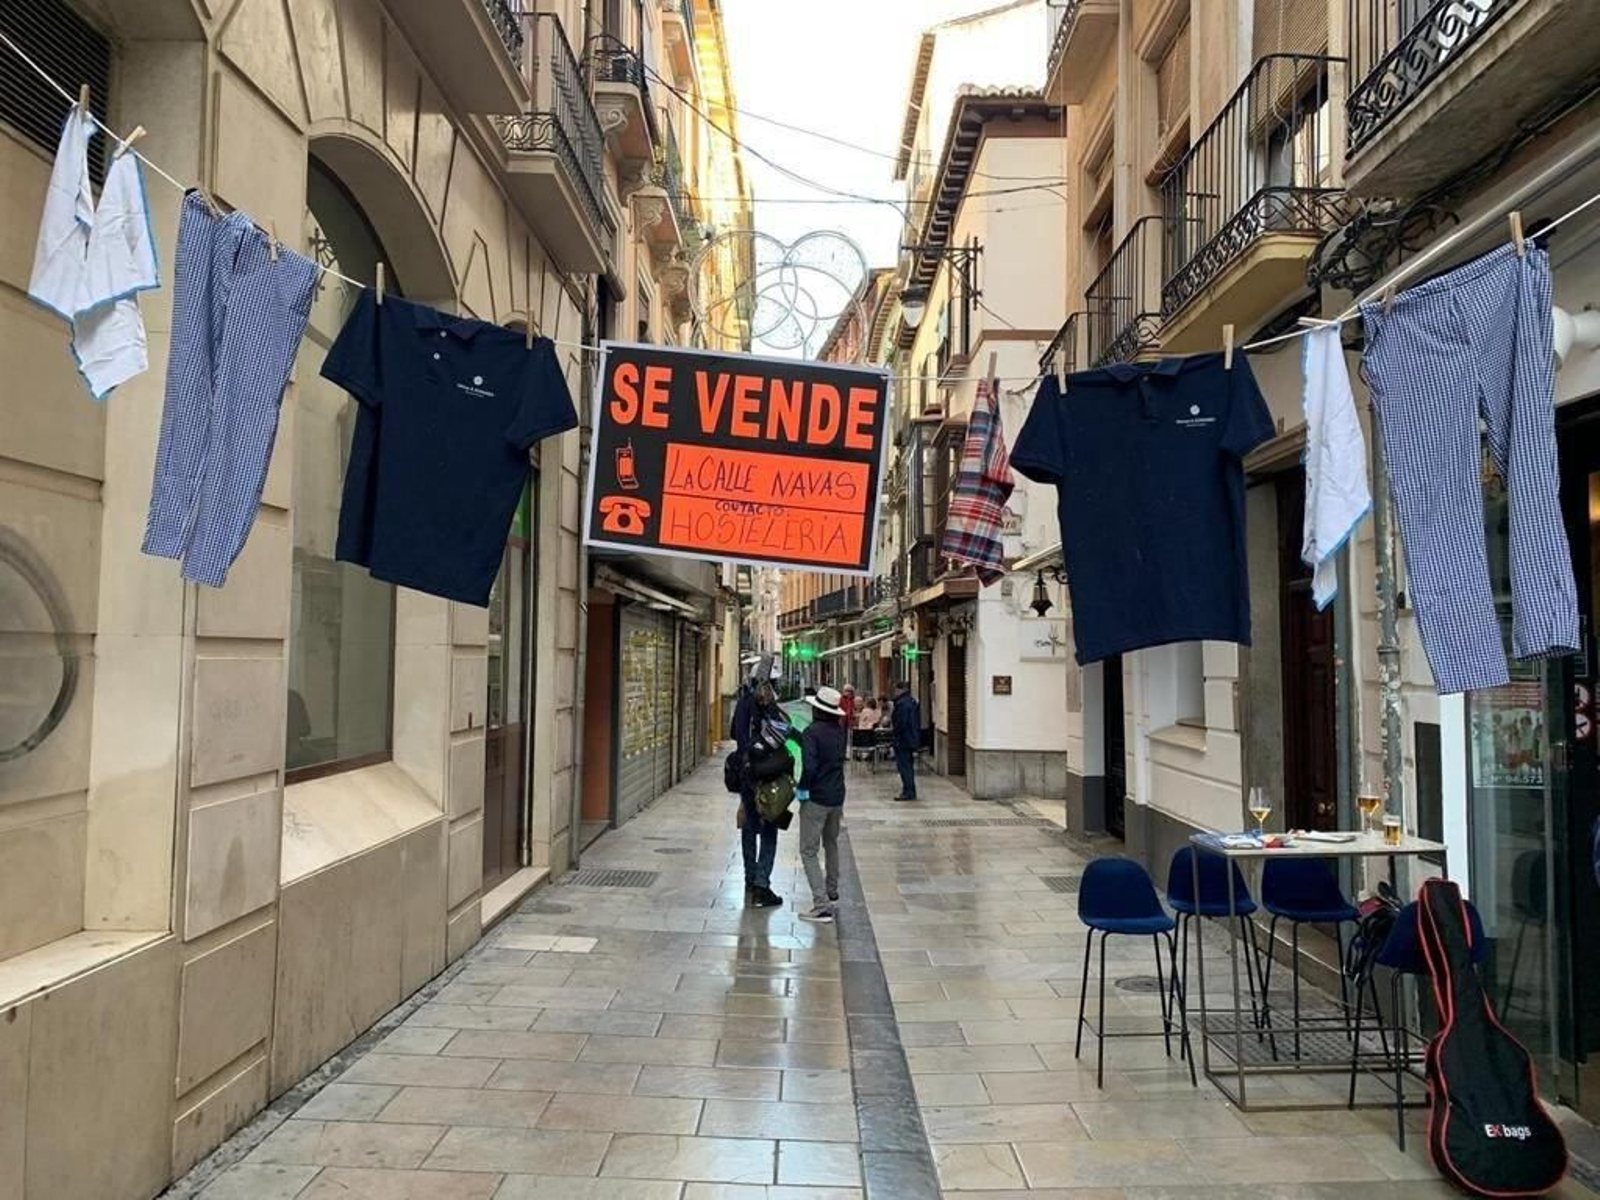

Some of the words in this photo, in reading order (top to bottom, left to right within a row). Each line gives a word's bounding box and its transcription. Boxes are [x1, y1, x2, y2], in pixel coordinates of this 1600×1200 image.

[610, 362, 672, 428] SE
[695, 371, 878, 450] VENDE
[697, 453, 758, 493] CALLE
[771, 470, 857, 500] NAVAS
